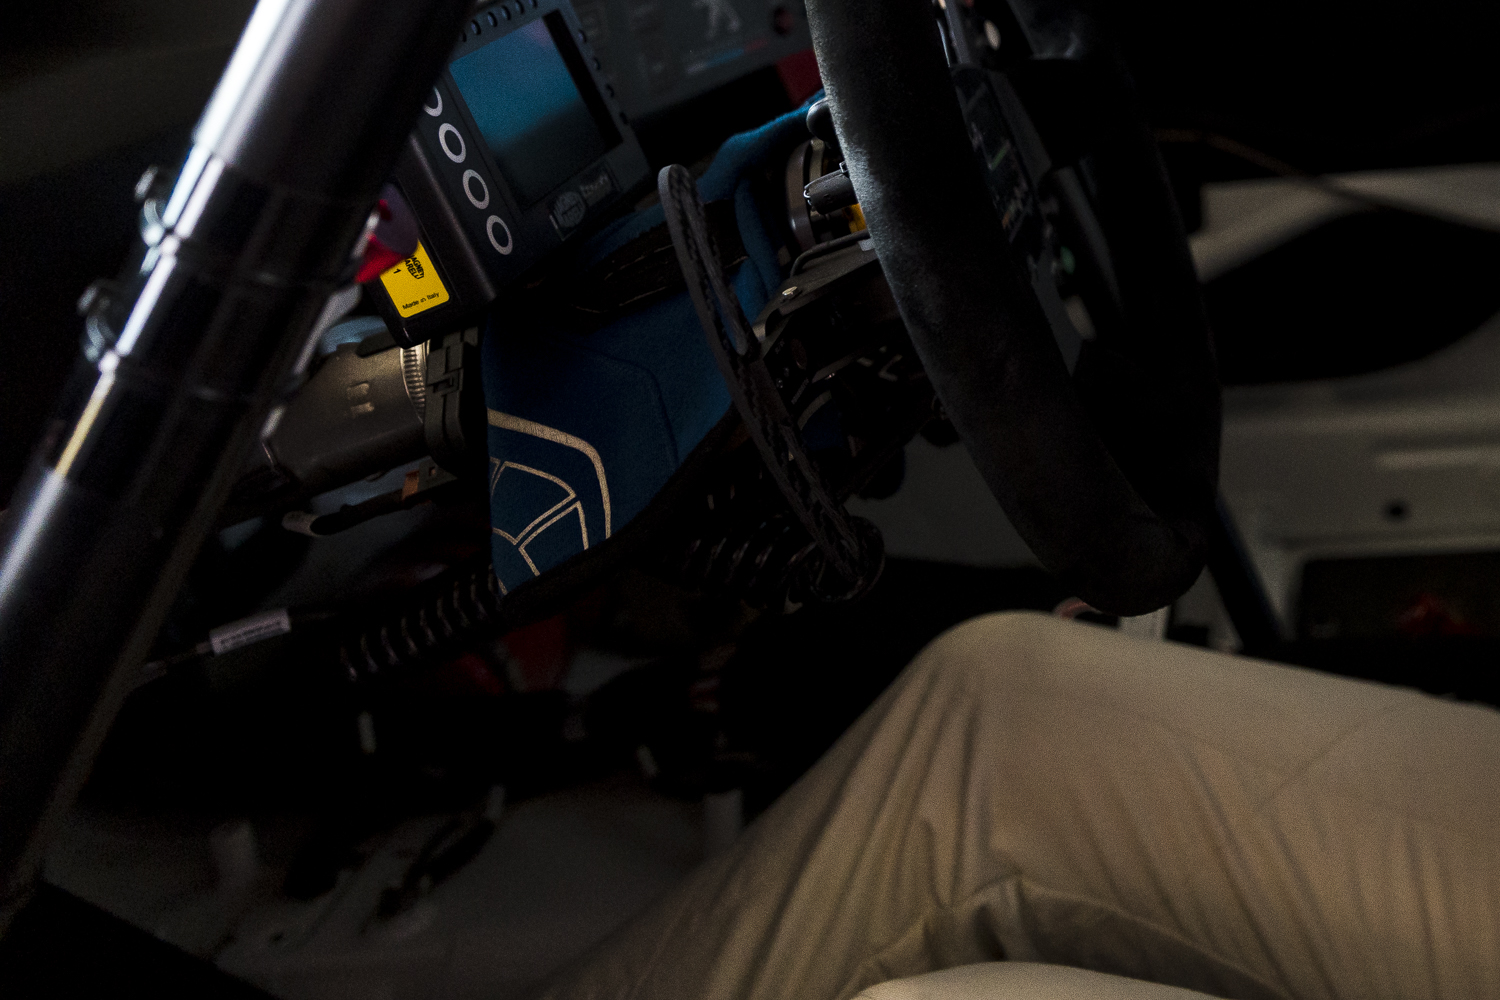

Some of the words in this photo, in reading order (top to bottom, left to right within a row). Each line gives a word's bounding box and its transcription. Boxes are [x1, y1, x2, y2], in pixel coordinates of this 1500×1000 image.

[404, 258, 423, 280] ARELLI
[409, 254, 425, 275] AGNETI
[402, 300, 419, 310] Made
